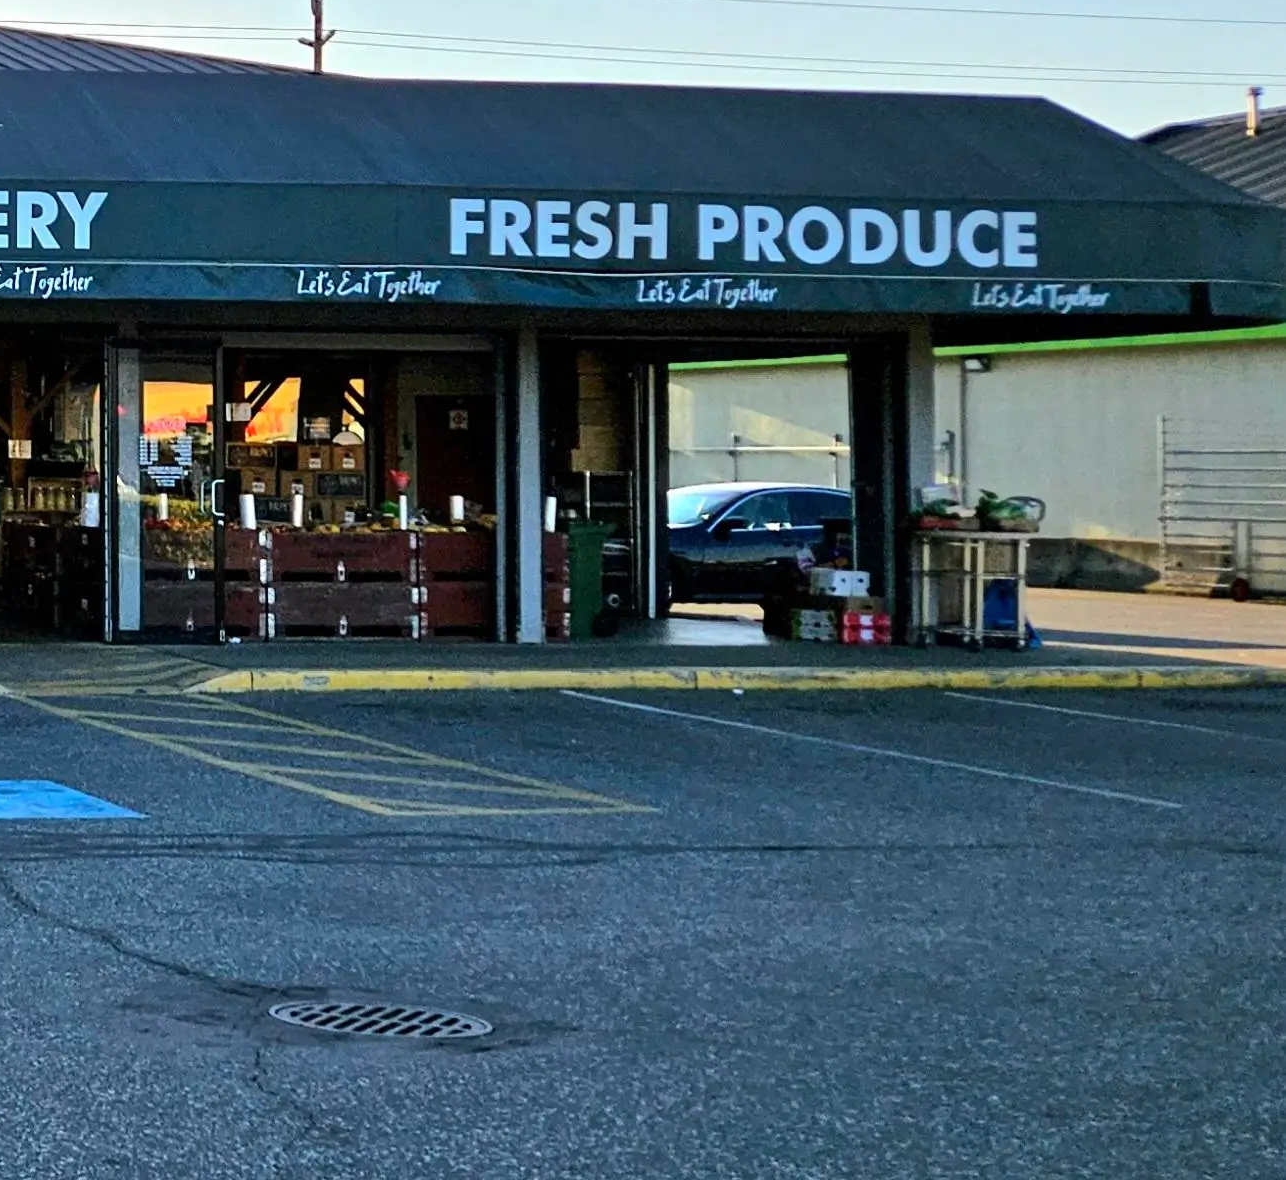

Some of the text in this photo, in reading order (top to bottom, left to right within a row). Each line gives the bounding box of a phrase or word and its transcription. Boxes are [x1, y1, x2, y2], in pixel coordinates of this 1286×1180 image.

[449, 198, 1039, 268] FRESH PRODUCE
[25, 265, 94, 299] Together
[297, 270, 441, 303] Let's Eat Together
[637, 278, 778, 309] Let's Eat Together
[1011, 283, 1043, 308] Eat
[1043, 283, 1111, 314] Together
